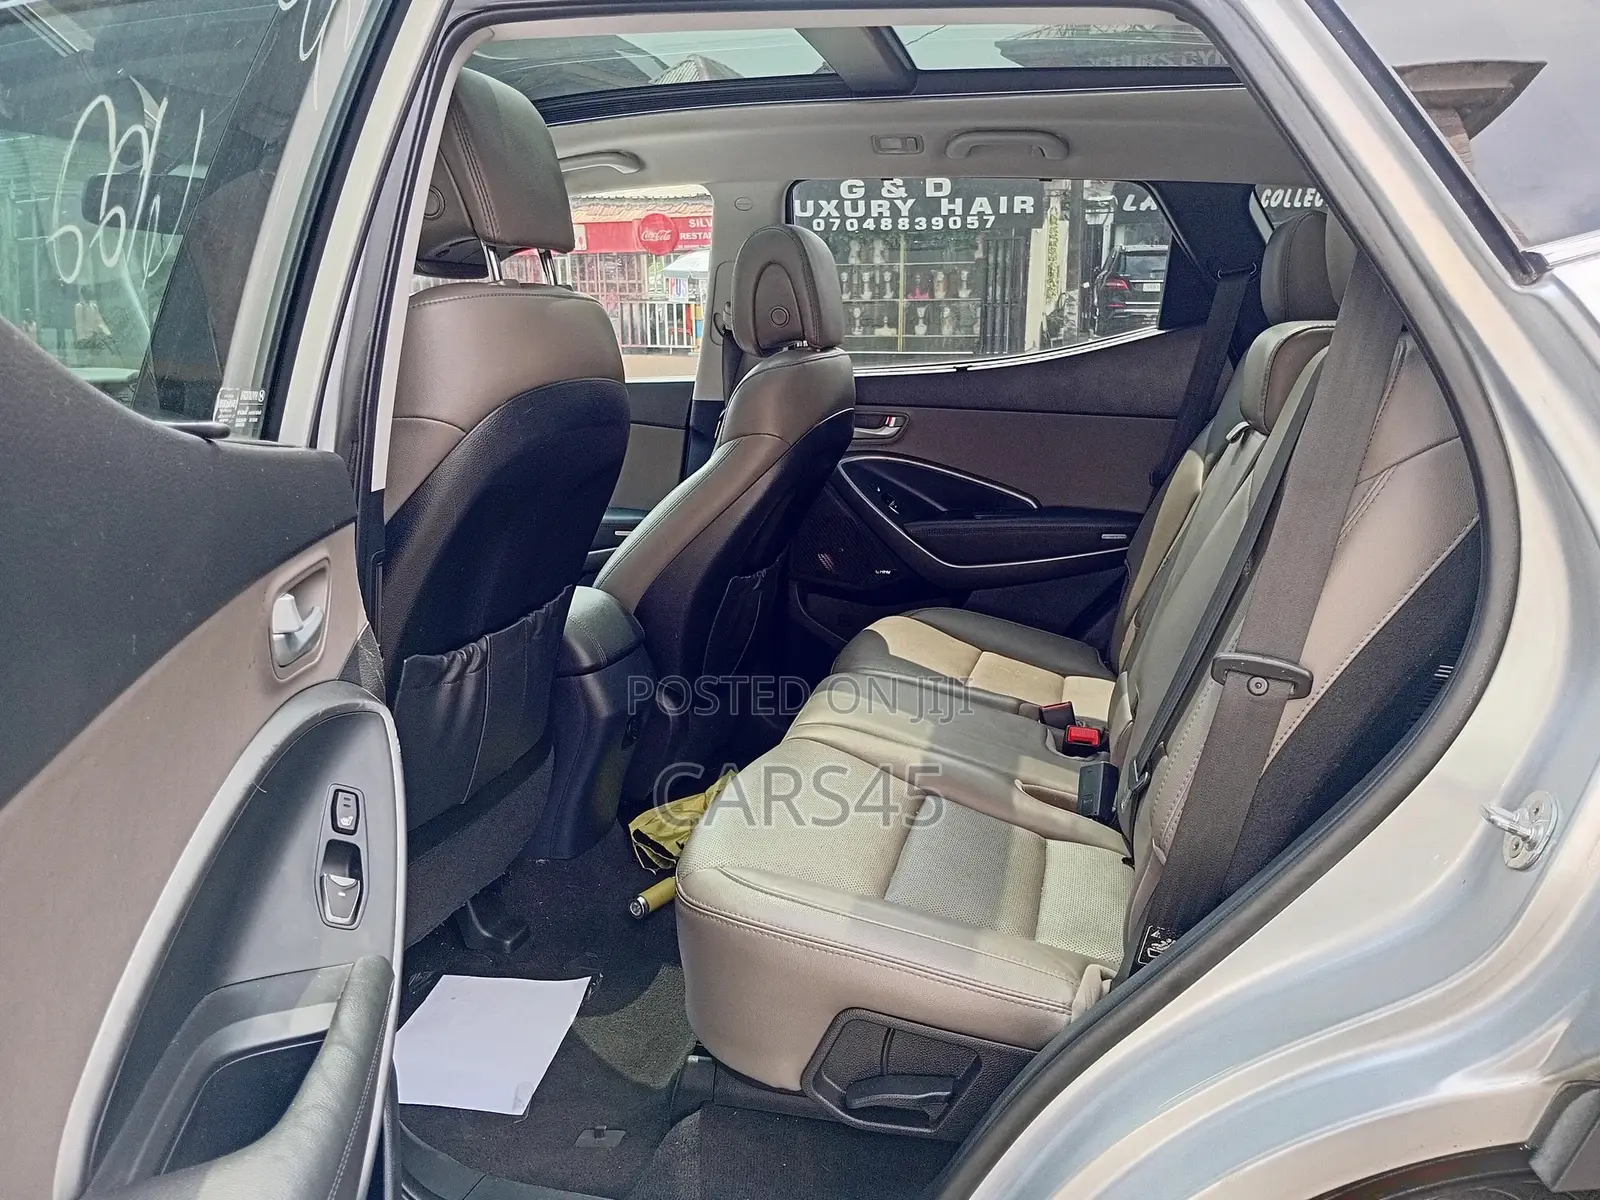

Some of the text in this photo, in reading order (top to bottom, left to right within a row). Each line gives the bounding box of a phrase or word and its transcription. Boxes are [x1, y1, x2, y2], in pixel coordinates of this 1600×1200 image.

[840, 177, 952, 199] G & D
[1260, 188, 1328, 208] COLLEC
[795, 196, 1035, 218] UXURY HAIR
[812, 216, 996, 232] 07048839057
